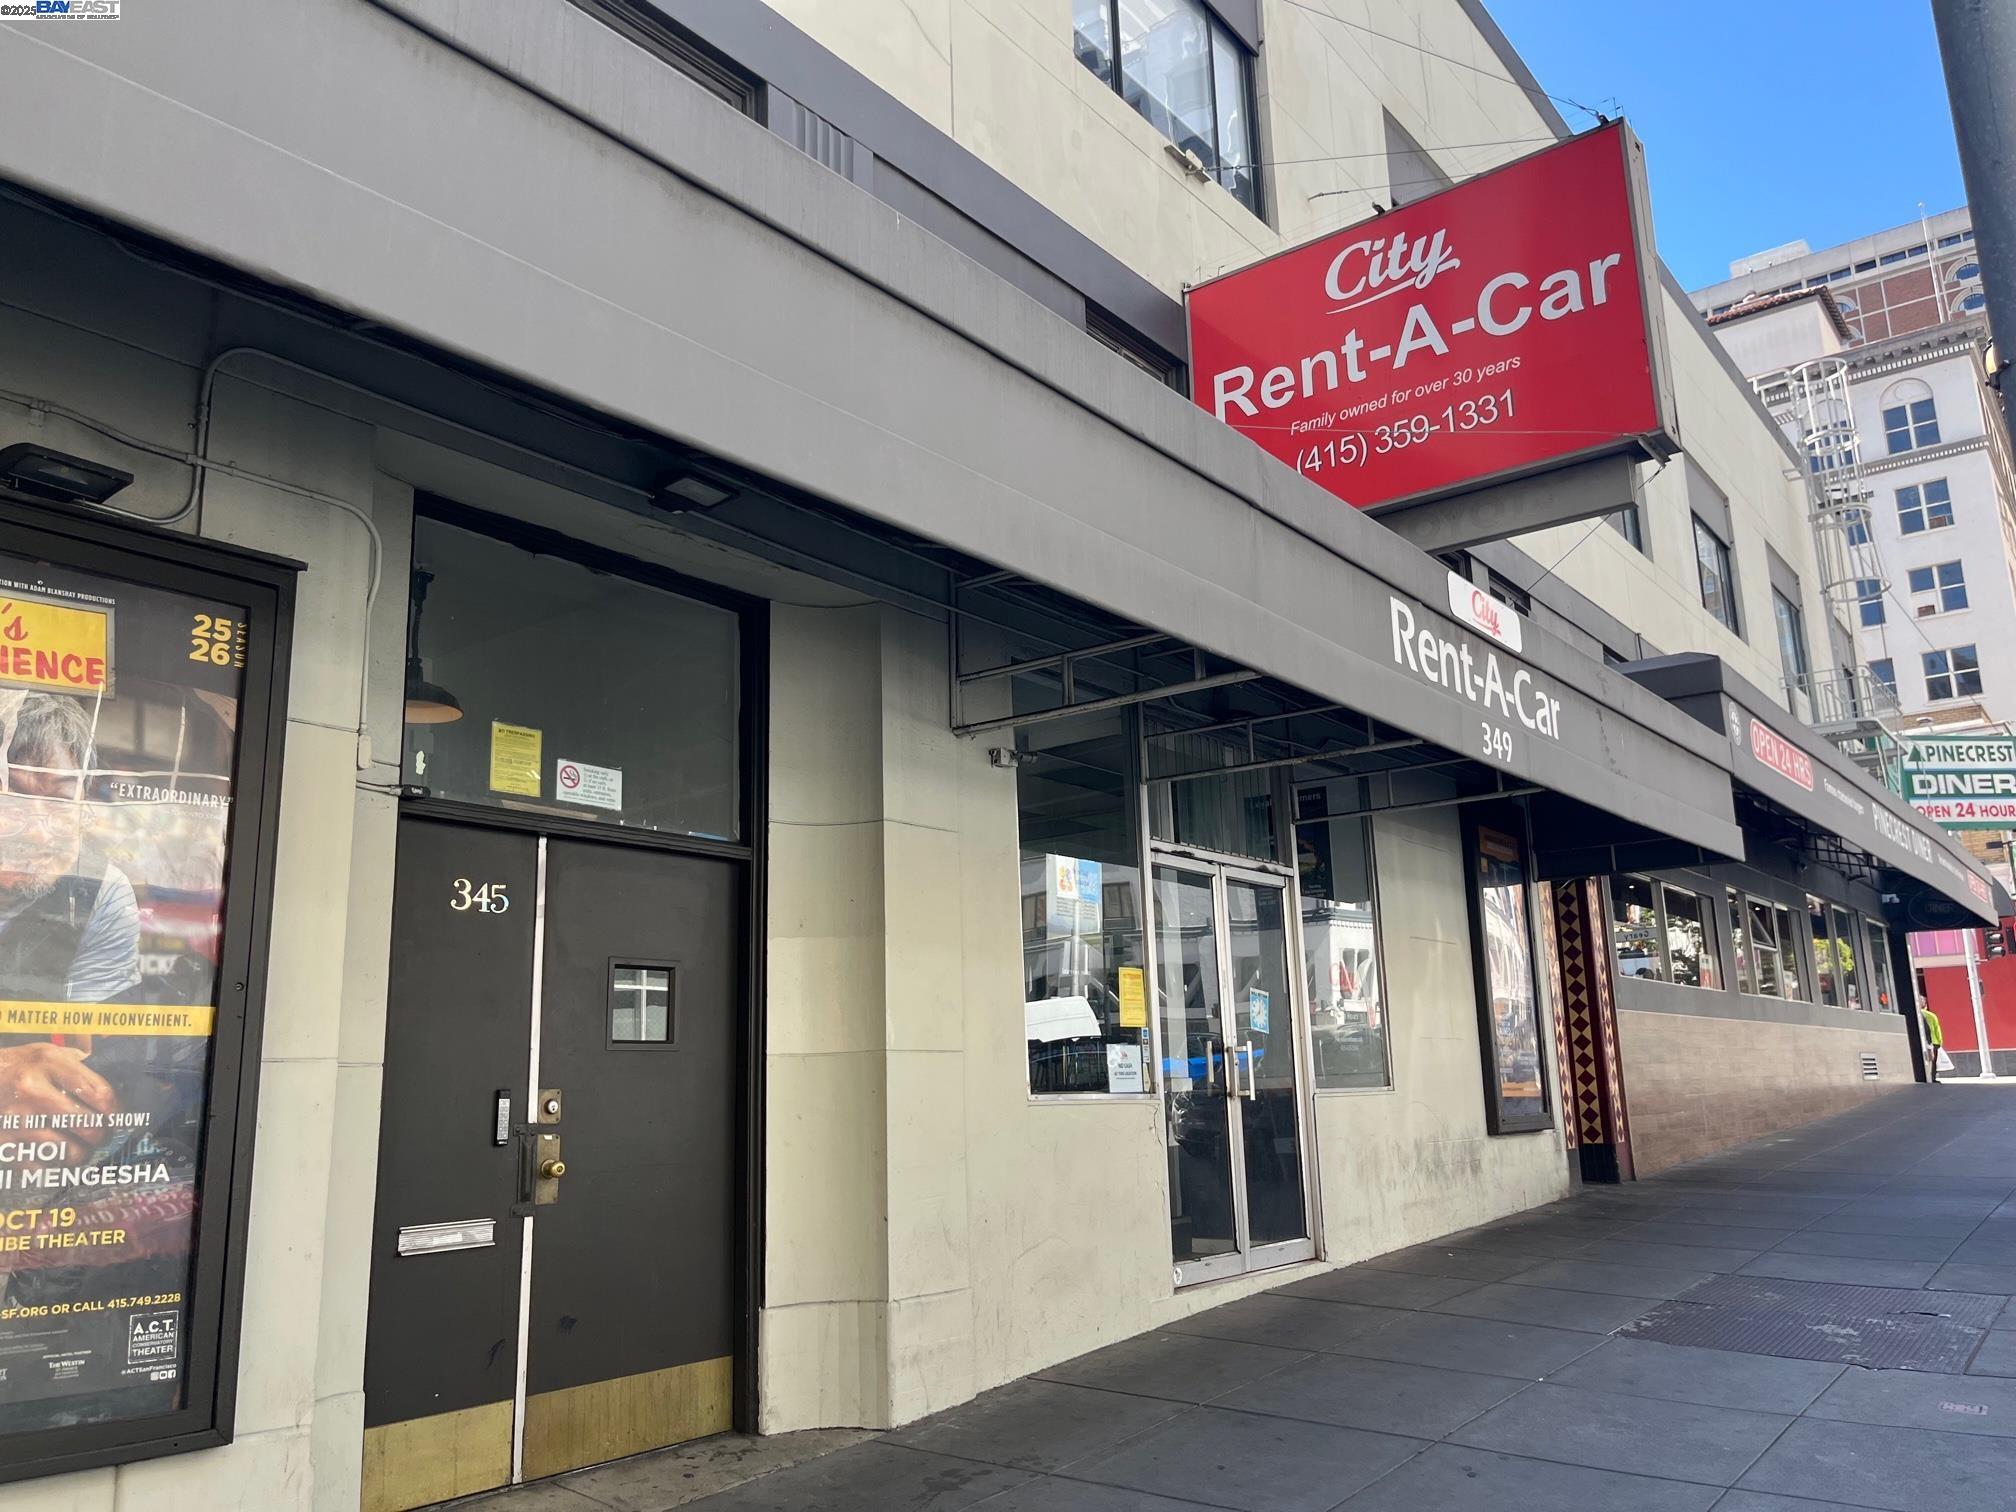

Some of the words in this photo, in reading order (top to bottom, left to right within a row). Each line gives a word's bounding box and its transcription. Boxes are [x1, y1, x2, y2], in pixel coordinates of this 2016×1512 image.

[1324, 228, 1460, 308] City
[1212, 252, 1621, 424] Rent-A-Car
[1290, 409, 1337, 436] Family
[1339, 393, 1387, 421] owned
[1390, 385, 1412, 407] for
[1415, 380, 1449, 399] over
[1452, 367, 1473, 386] 30
[1475, 355, 1521, 384] years
[1296, 431, 1369, 476] (415)
[1374, 389, 1516, 456] 359-1331
[13, 581, 29, 590] WITH
[30, 584, 46, 593] ADAM
[47, 587, 76, 599] BLANSHAY
[77, 593, 116, 605] PRODUCTIONS
[1471, 590, 1502, 637] City
[191, 614, 232, 642] 25
[189, 638, 230, 666] 26
[1389, 596, 1561, 741] Rent-A-Car
[1481, 721, 1513, 763] 349
[1752, 725, 1780, 767] OPEN
[1779, 743, 1793, 774] 24
[1925, 745, 2013, 762] PINECREST
[1911, 773, 2016, 795] DINER
[1916, 805, 1951, 818] OPEN
[1955, 802, 1975, 817] 24
[450, 878, 510, 914] 345
[7, 1009, 58, 1024] MATTER
[63, 1011, 93, 1025] HOW
[98, 1012, 193, 1028] INCONVENIENT.
[25, 1113, 47, 1129] HIT
[51, 1113, 104, 1129] NETFLIX
[108, 1112, 151, 1127] SHOW!
[0, 1141, 67, 1163] CHOI
[21, 1163, 170, 1189] MENGESHA
[49, 1207, 76, 1228] 19
[36, 1229, 126, 1249] THEATER
[51, 1303, 70, 1315] OR
[72, 1301, 105, 1313] CALL
[107, 1293, 182, 1310] 415.749.2228
[132, 1331, 175, 1342] AMERICAN
[133, 1319, 174, 1335] A.C.T.
[131, 1345, 173, 1357] THEATER
